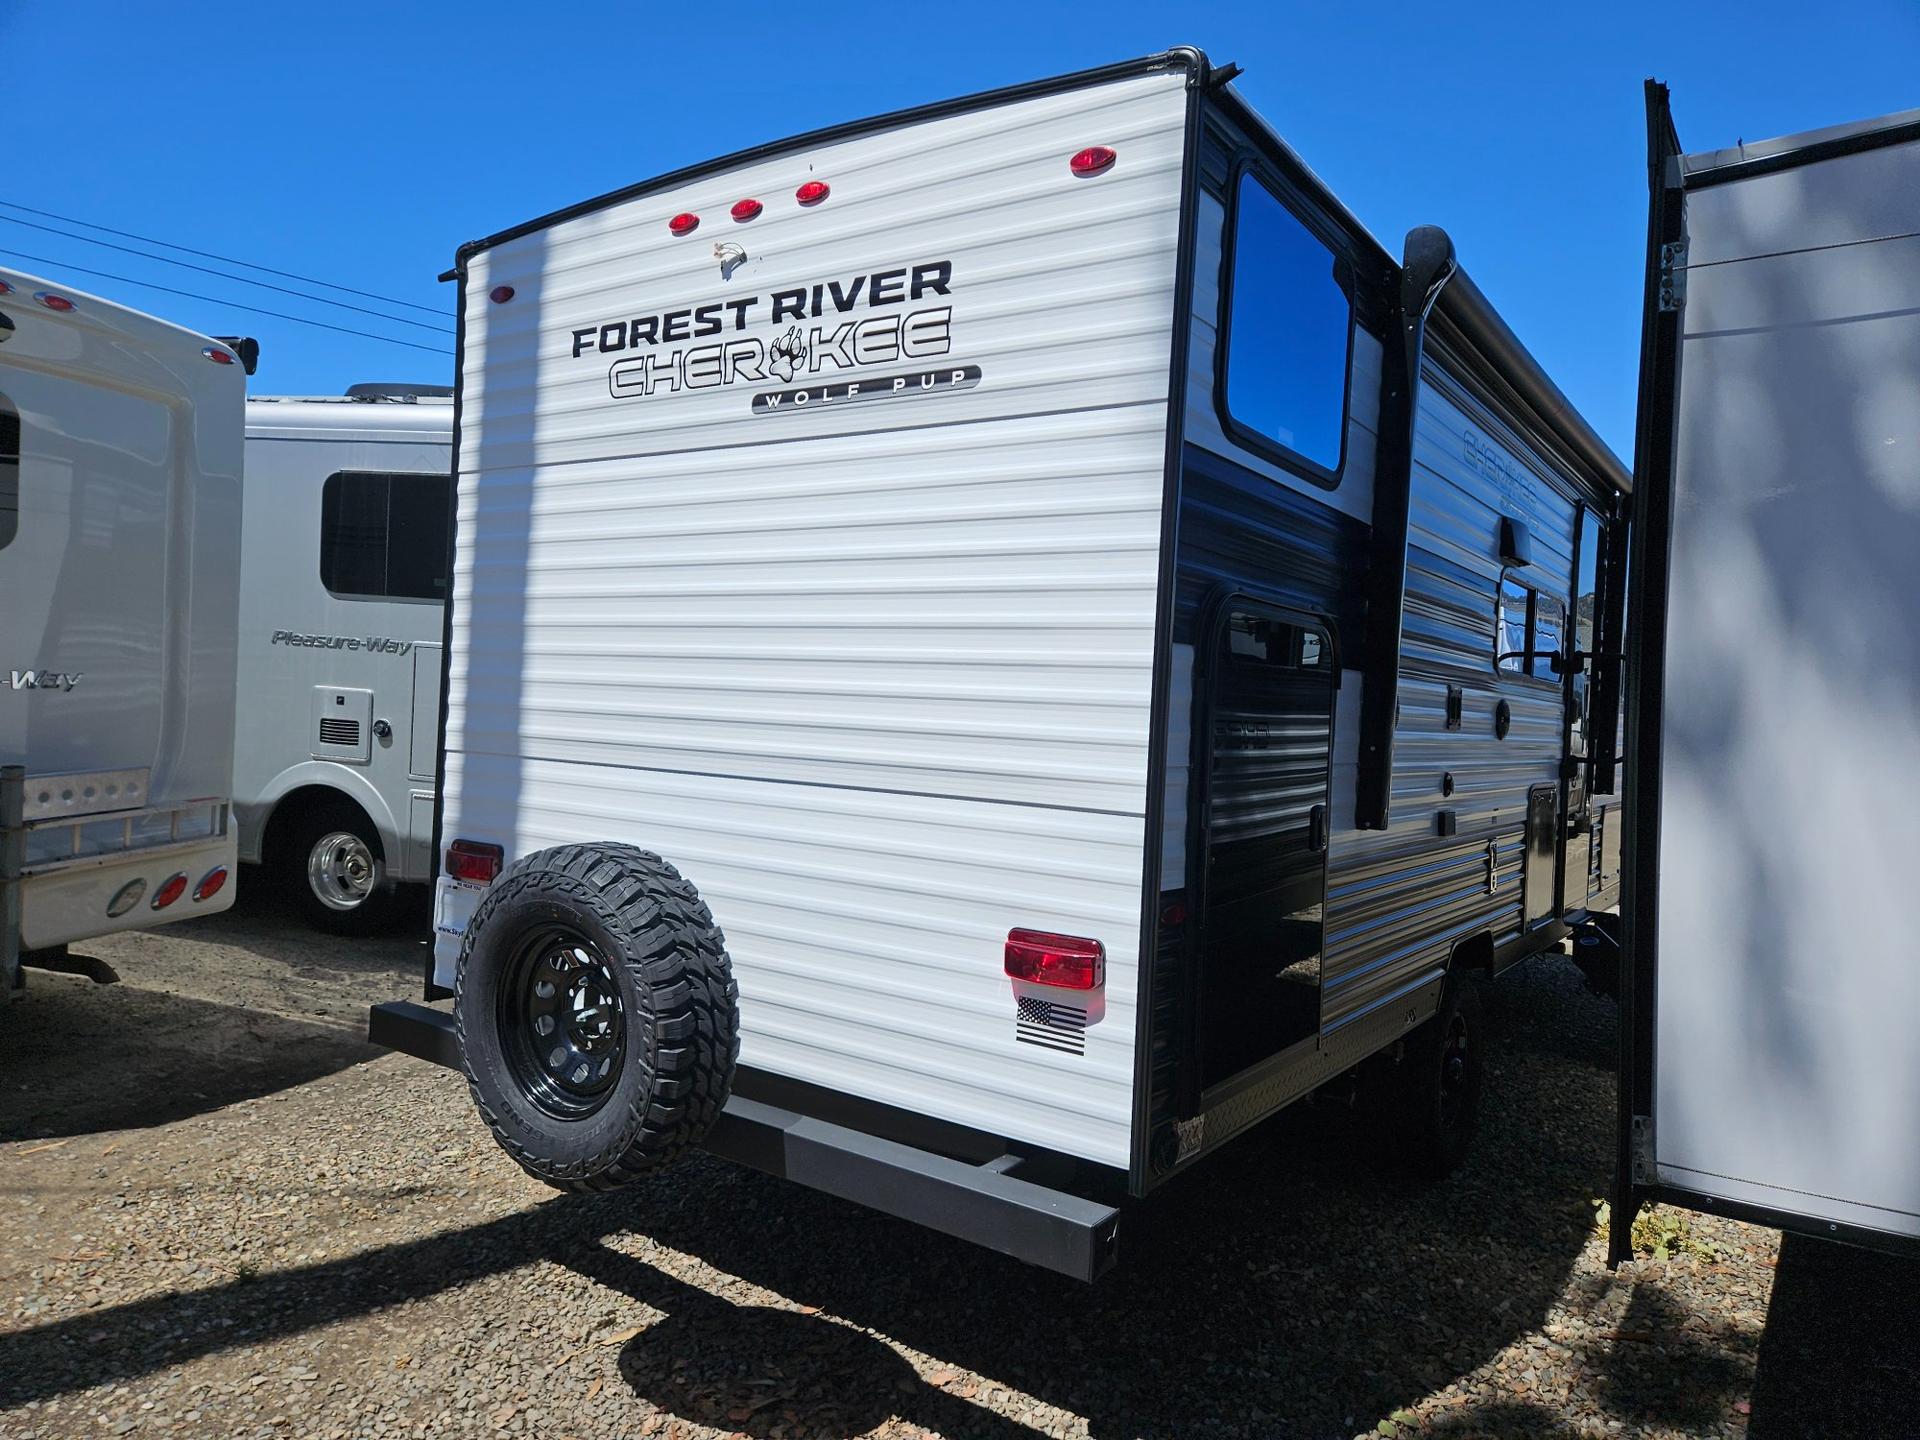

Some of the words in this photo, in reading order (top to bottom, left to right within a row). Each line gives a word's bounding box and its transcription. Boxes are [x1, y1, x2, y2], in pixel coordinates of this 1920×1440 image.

[572, 296, 758, 358] FOREST
[771, 260, 952, 324] RIVER
[765, 383, 861, 409] WOLF
[893, 370, 966, 394] PUP
[271, 629, 412, 656] Pleasure-Way
